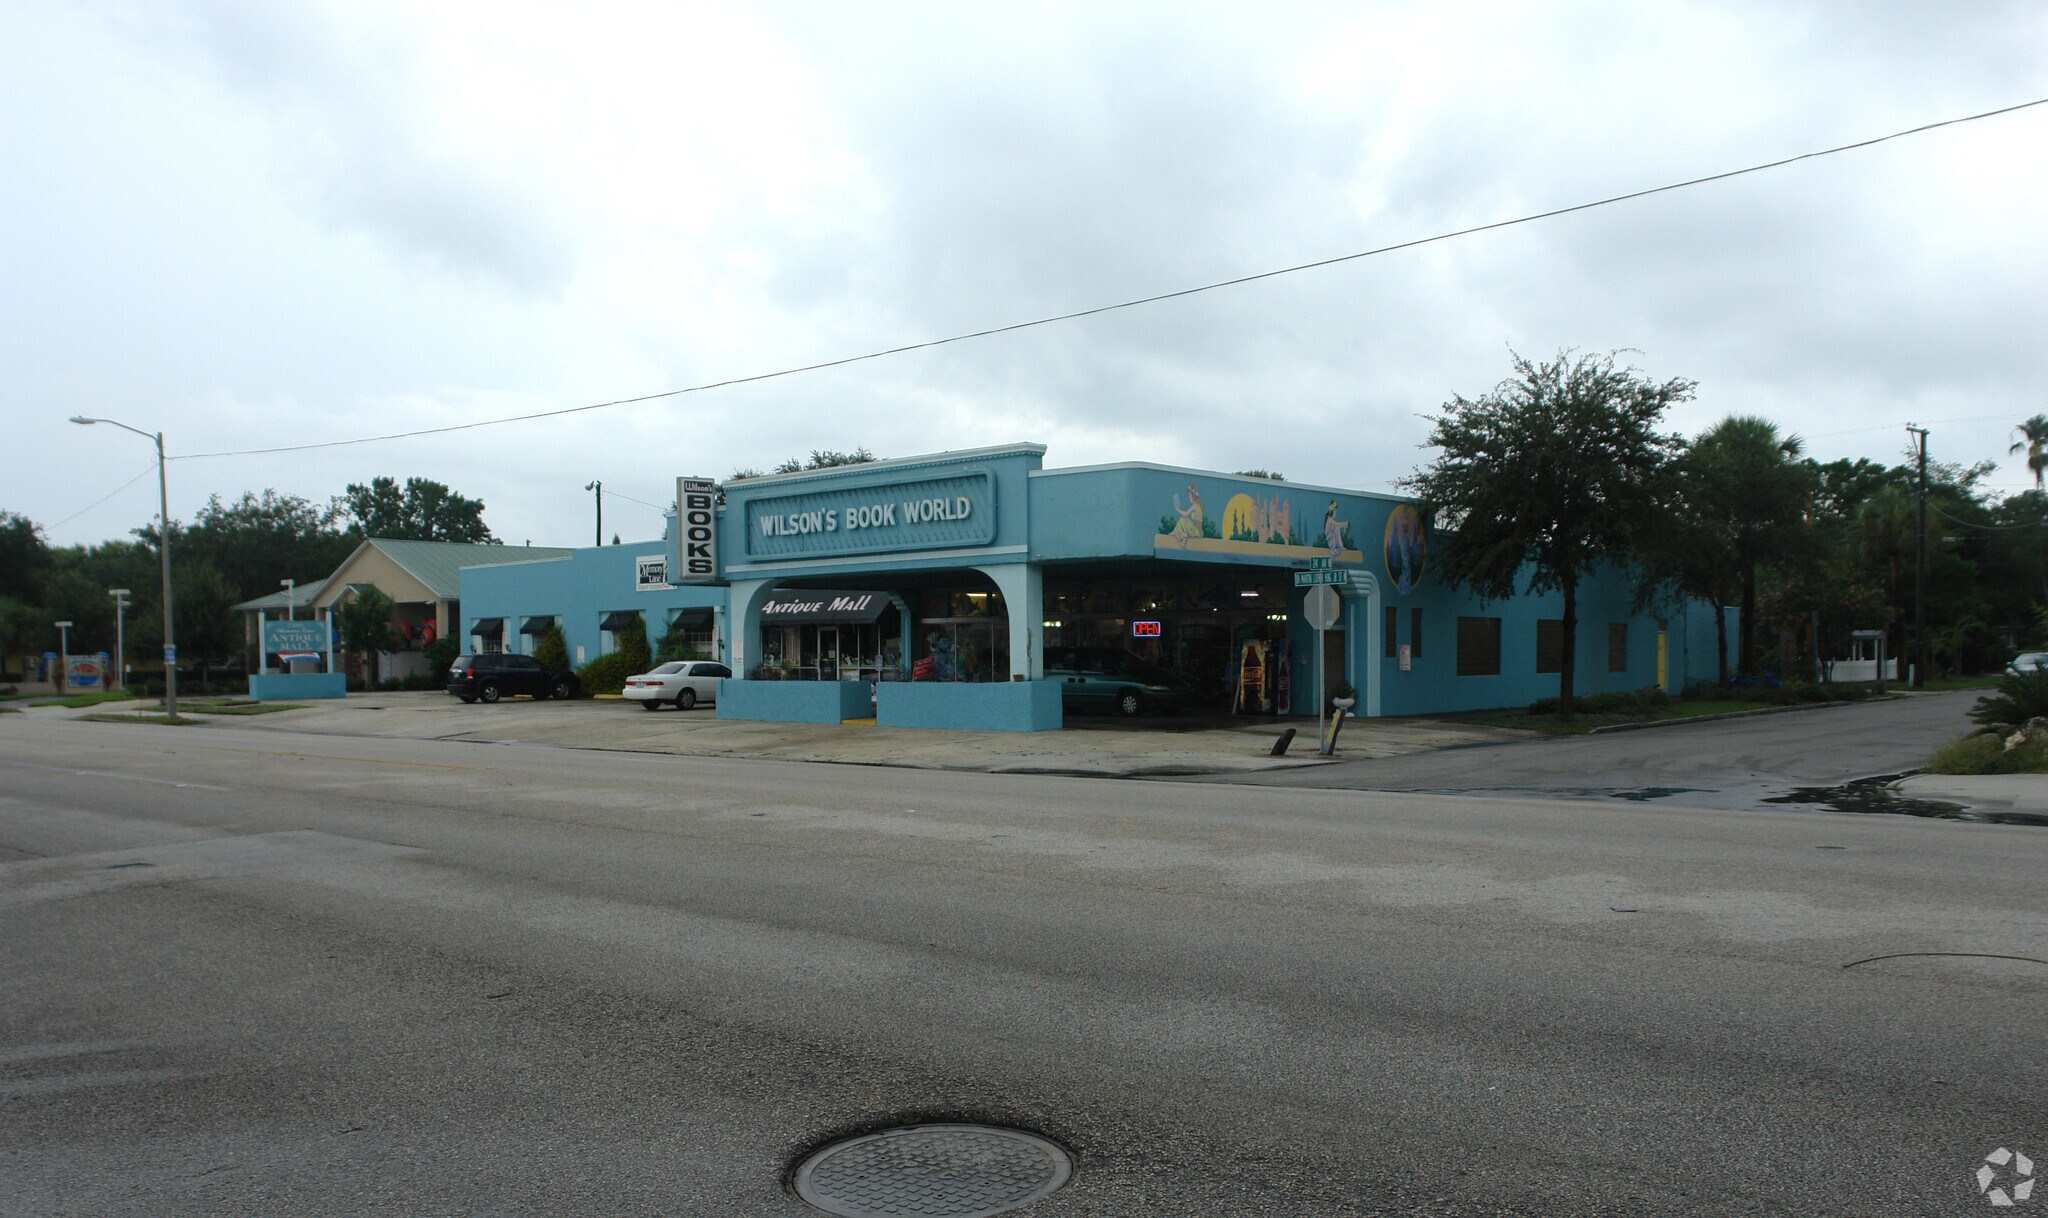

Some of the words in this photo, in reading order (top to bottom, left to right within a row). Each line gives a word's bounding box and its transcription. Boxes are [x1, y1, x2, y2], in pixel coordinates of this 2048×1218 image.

[685, 481, 712, 493] Wilson's
[760, 507, 838, 536] WILSON'S
[846, 503, 896, 530] BOOK
[904, 496, 971, 524] WORLD
[687, 494, 713, 573] BOOKS
[640, 564, 663, 577] Memory
[648, 575, 662, 583] Lane
[1135, 623, 1160, 635] OPEN
[280, 643, 312, 651] MALL
